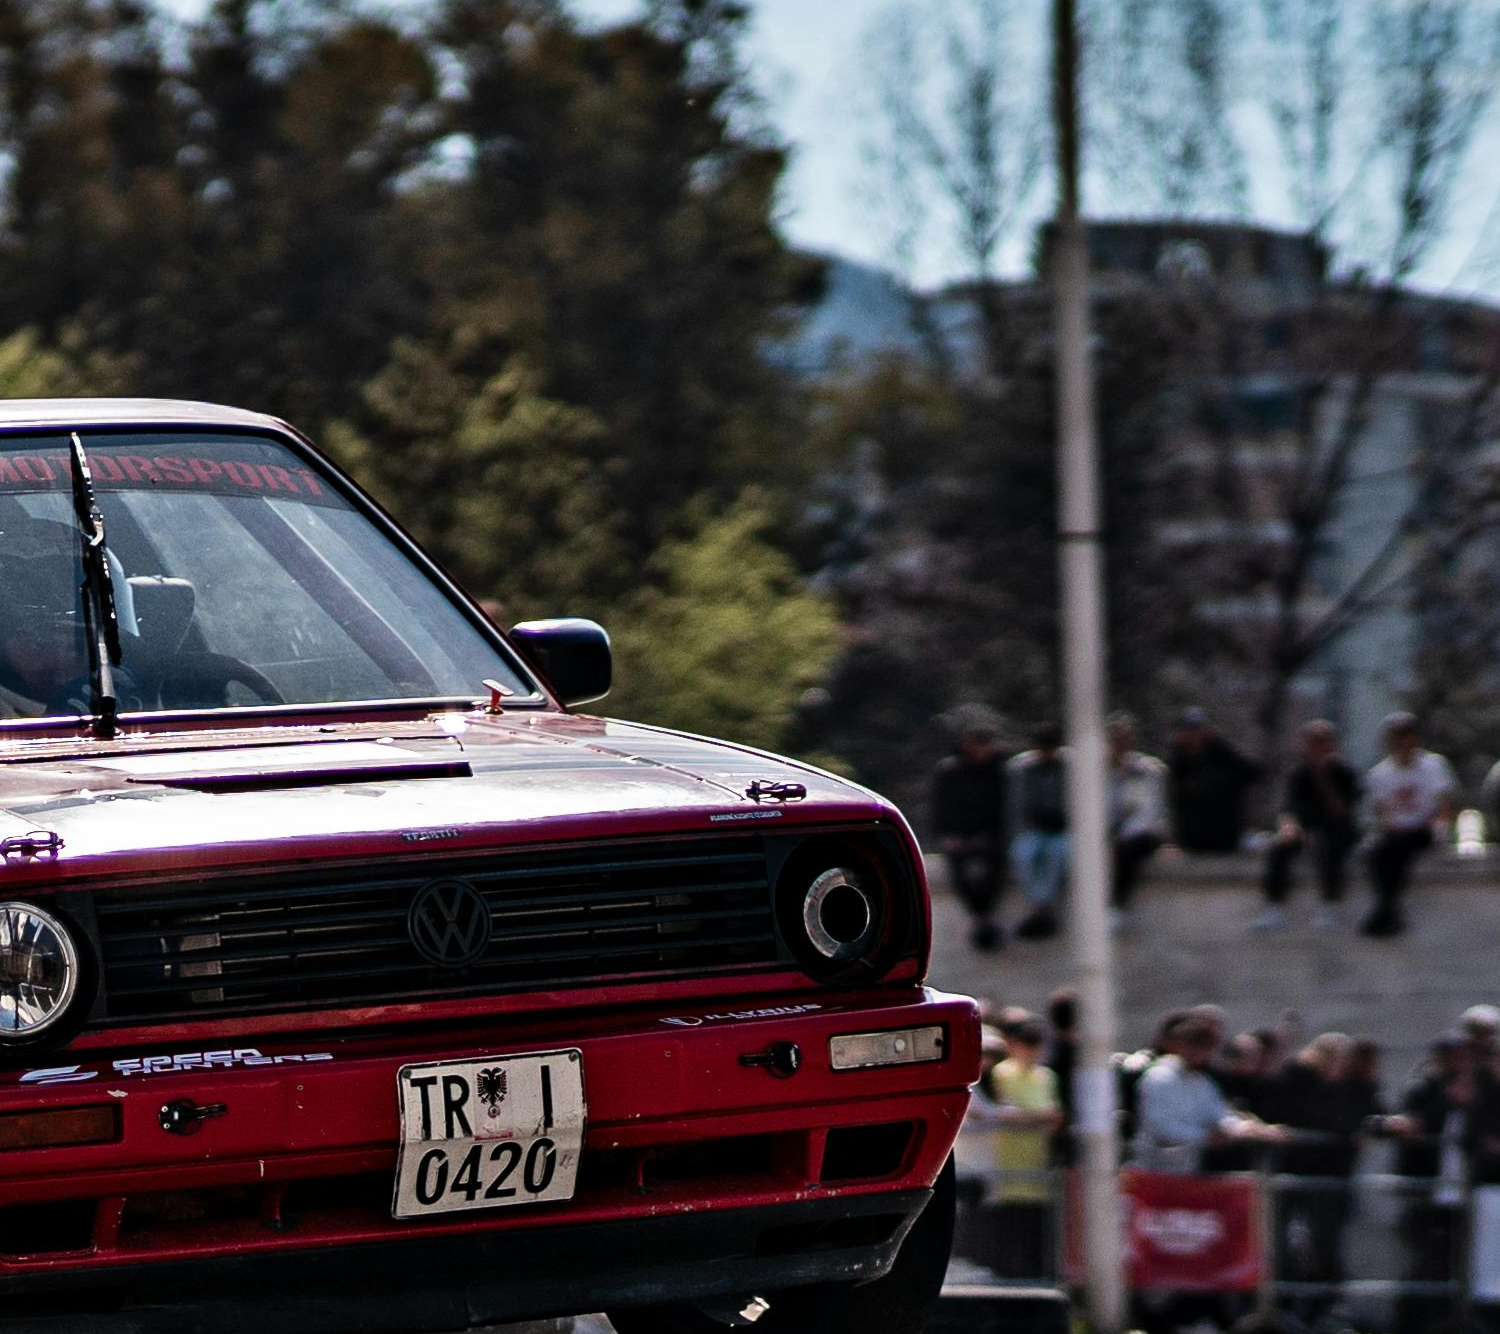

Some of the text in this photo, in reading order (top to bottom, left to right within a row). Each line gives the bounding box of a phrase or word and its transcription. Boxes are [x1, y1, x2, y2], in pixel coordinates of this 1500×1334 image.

[112, 1047, 262, 1073] SPEED
[410, 1074, 473, 1141] TR
[415, 1137, 557, 1206] 0420
